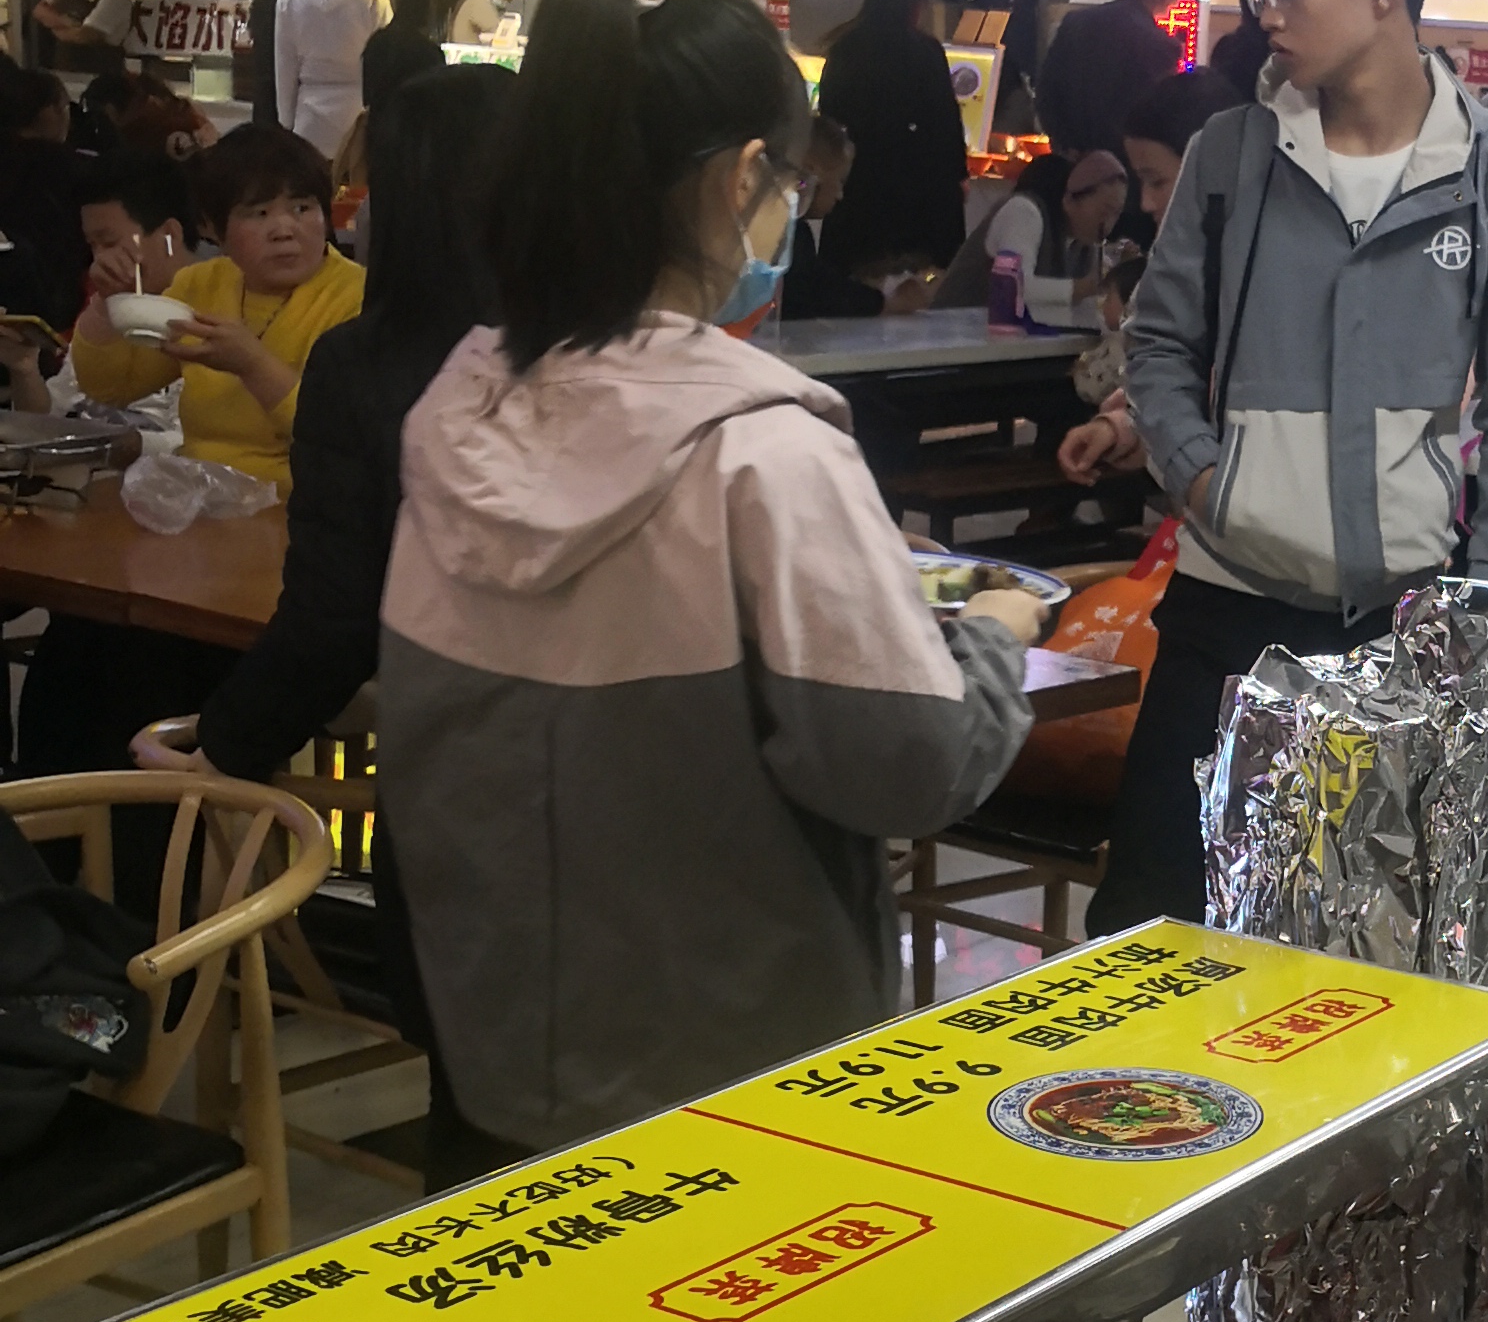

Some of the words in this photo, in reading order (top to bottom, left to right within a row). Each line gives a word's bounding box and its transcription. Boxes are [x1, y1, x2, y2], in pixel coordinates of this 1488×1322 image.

[938, 943, 1179, 1034] 茄汁牛肉面
[1009, 956, 1247, 1051] 原汤牛肉面
[1229, 997, 1370, 1054] 招牌菜
[775, 1038, 945, 1098] 11.9元
[850, 1060, 1003, 1117] 9.9元
[385, 1168, 741, 1310] 牛骨粉丝汤
[693, 1217, 898, 1308] 招牌菜
